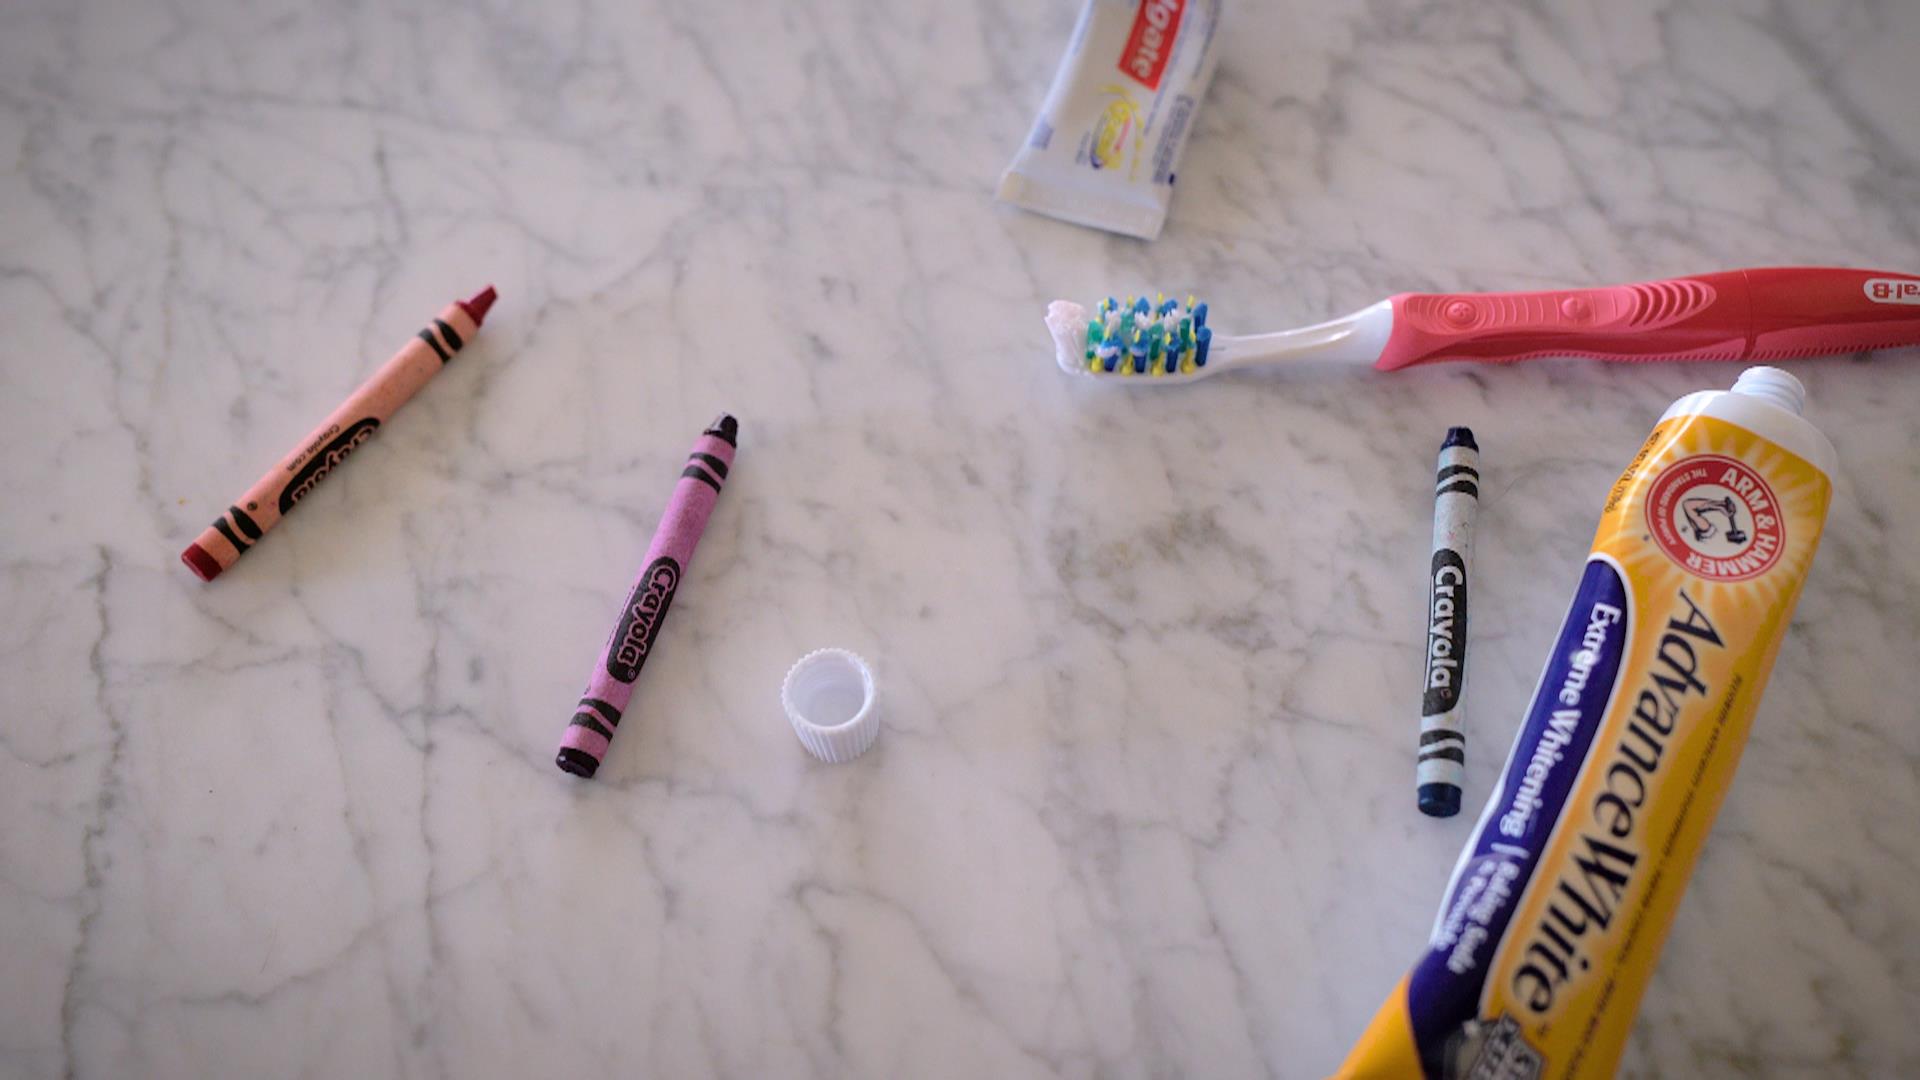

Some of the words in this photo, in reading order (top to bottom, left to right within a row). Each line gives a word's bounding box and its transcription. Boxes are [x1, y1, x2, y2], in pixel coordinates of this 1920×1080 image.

[1131, 0, 1179, 78] lgate
[1872, 283, 1920, 299] al-B
[1720, 467, 1766, 512] ARM
[1755, 514, 1776, 530] &
[1686, 532, 1777, 576] HAMMER
[617, 565, 676, 668] Crayola
[1430, 566, 1464, 688] Crayola
[1558, 601, 1622, 707] Extreme
[1499, 709, 1583, 839] Whitening
[1511, 587, 1727, 1014] AdvanceWhite
